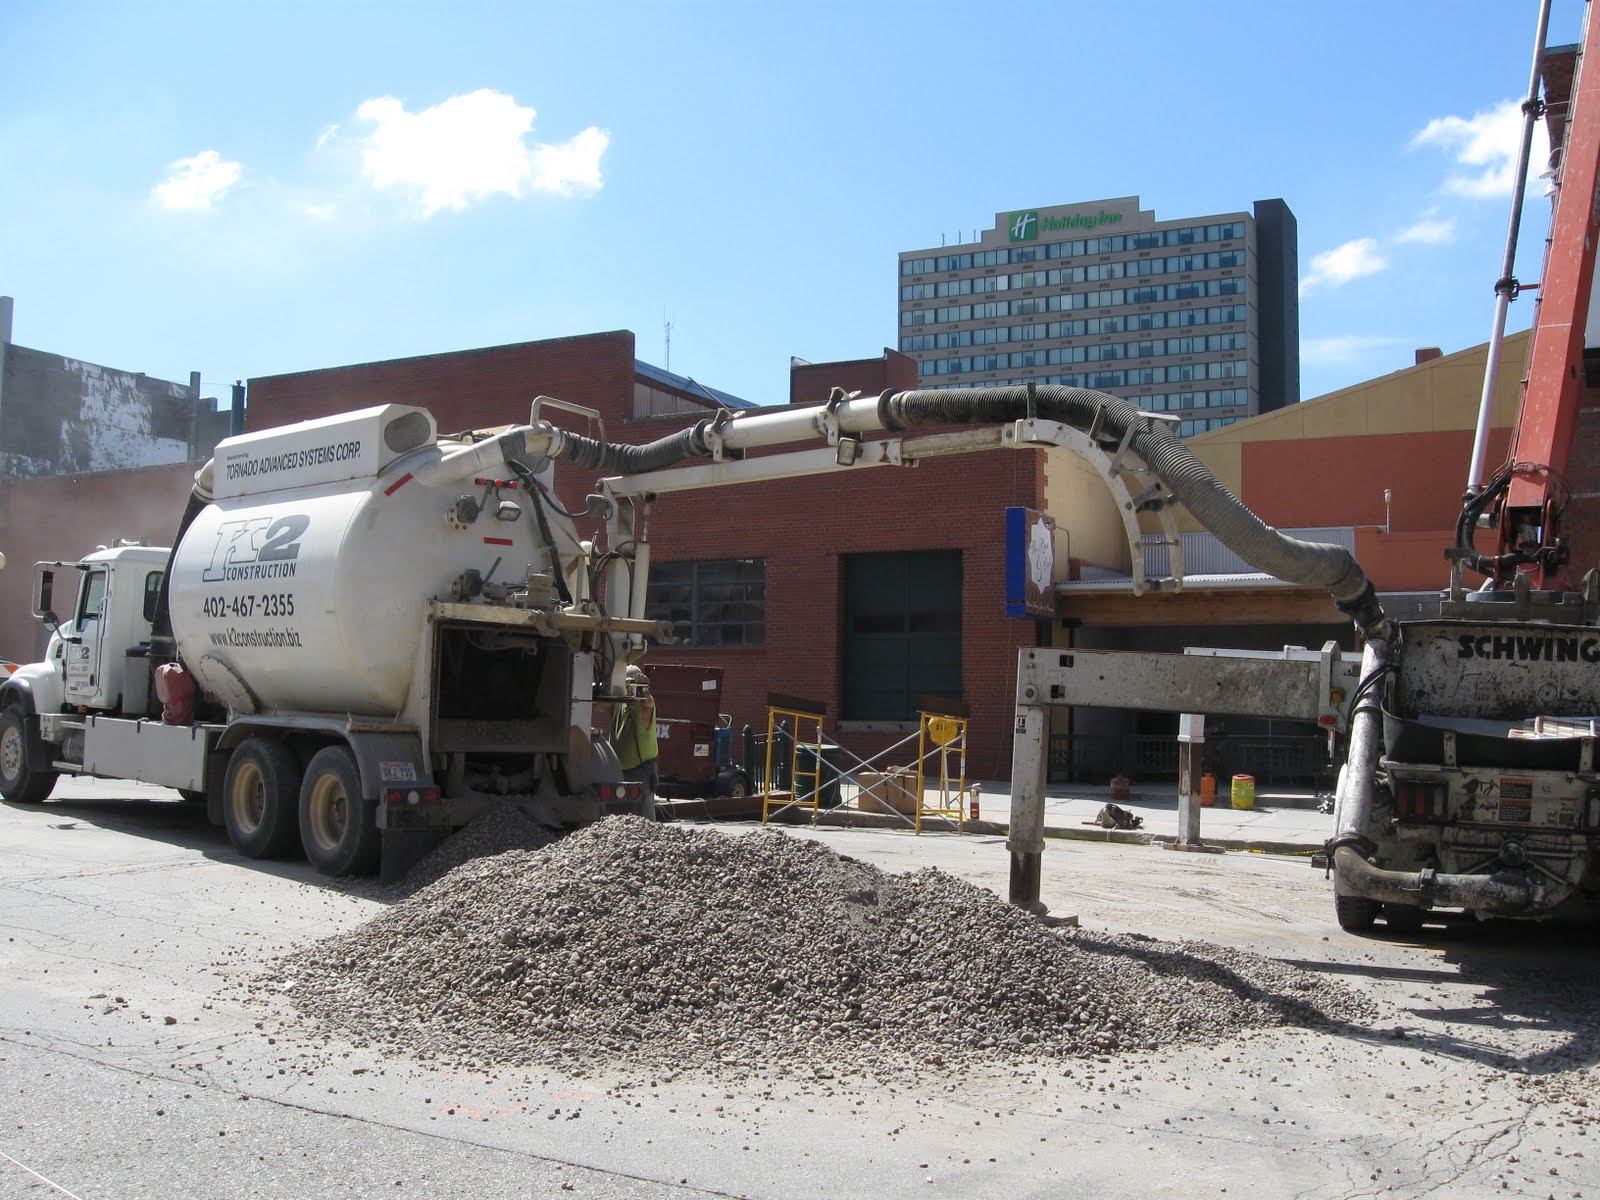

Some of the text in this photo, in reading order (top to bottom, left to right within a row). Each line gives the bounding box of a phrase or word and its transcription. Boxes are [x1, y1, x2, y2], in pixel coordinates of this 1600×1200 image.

[1041, 209, 1122, 232] Holiday Inn
[226, 440, 361, 480] TORNADO ADVANCED SYSTEMS CORP.
[202, 514, 311, 582] K2
[226, 562, 297, 581] CONSTRUCTION
[203, 593, 295, 618] 402-467-2355
[209, 626, 302, 648] www.k2construction.biz
[1457, 634, 1600, 663] SCHWING
